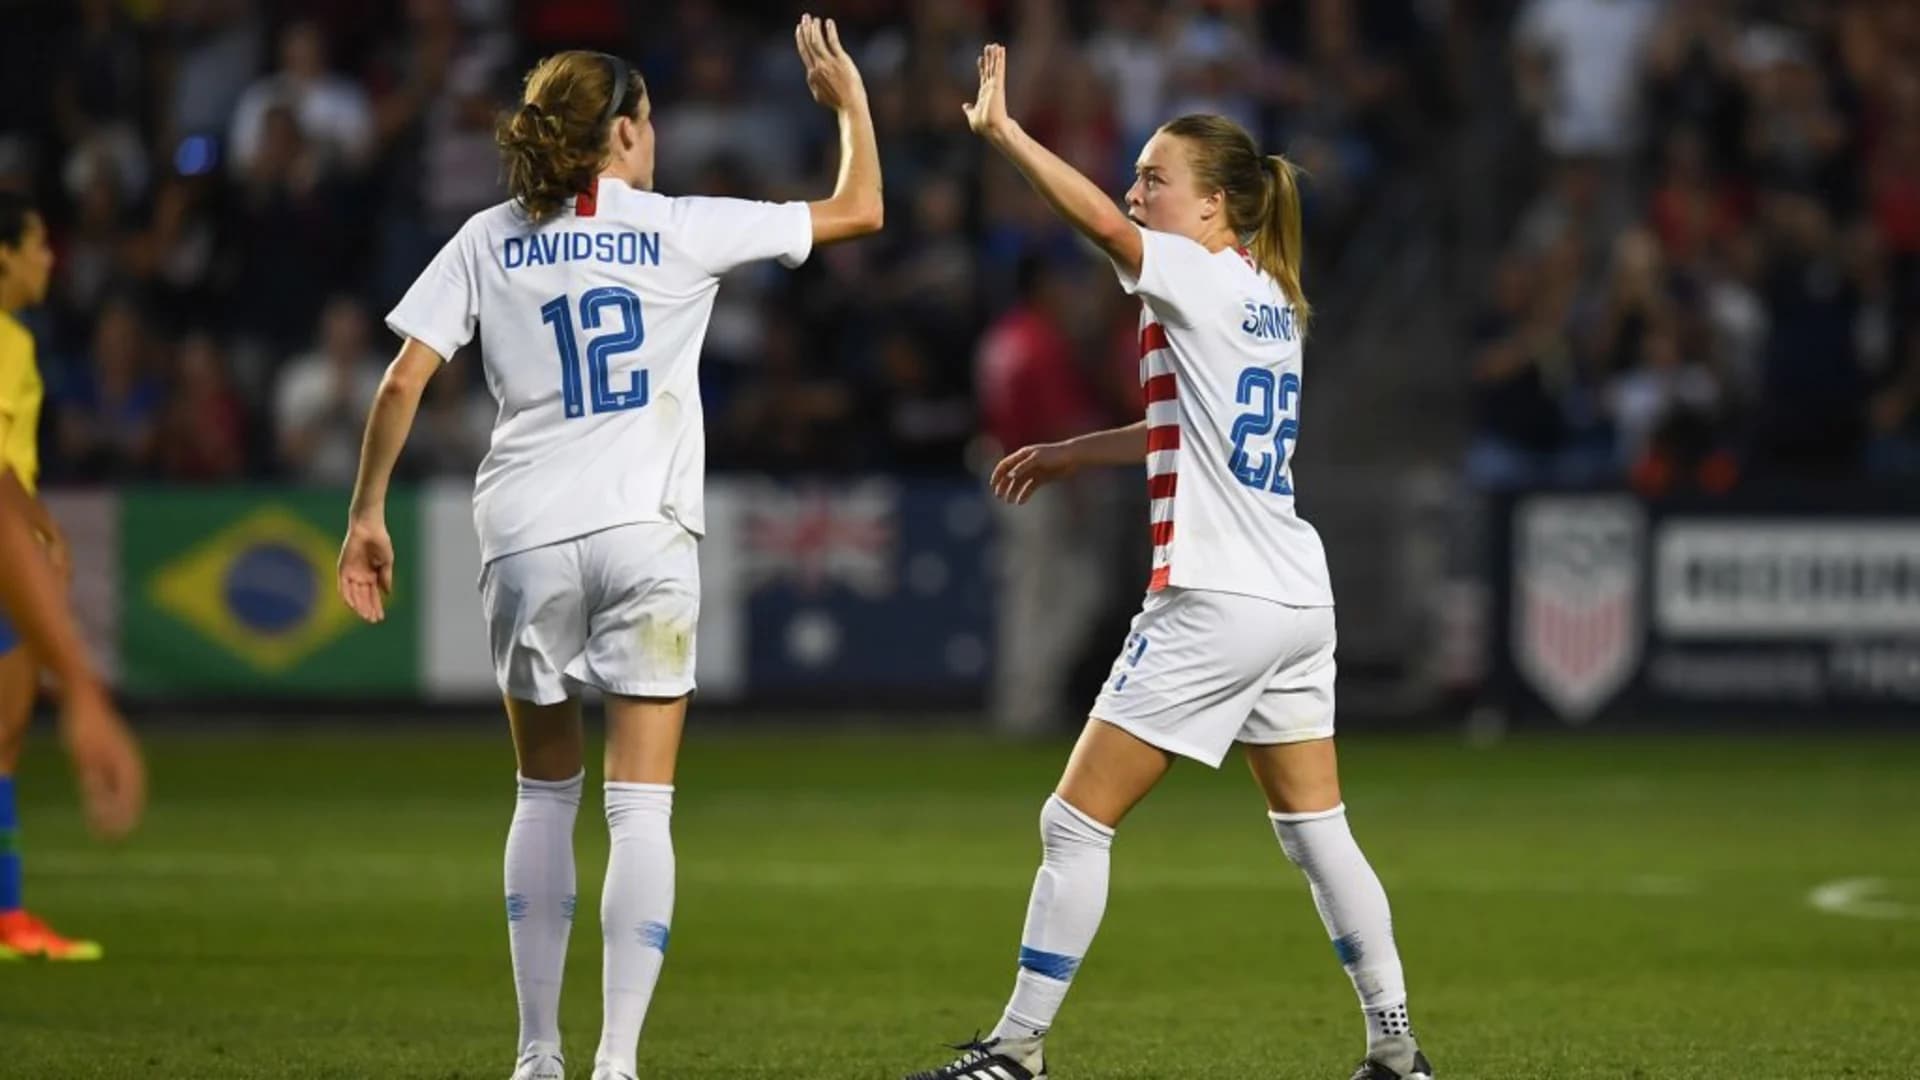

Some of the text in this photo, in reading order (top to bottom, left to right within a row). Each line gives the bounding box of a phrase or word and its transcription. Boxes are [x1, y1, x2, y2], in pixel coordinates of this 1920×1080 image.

[504, 232, 661, 268] DAVIDSON
[541, 286, 649, 419] 12
[1228, 366, 1300, 496] 22
